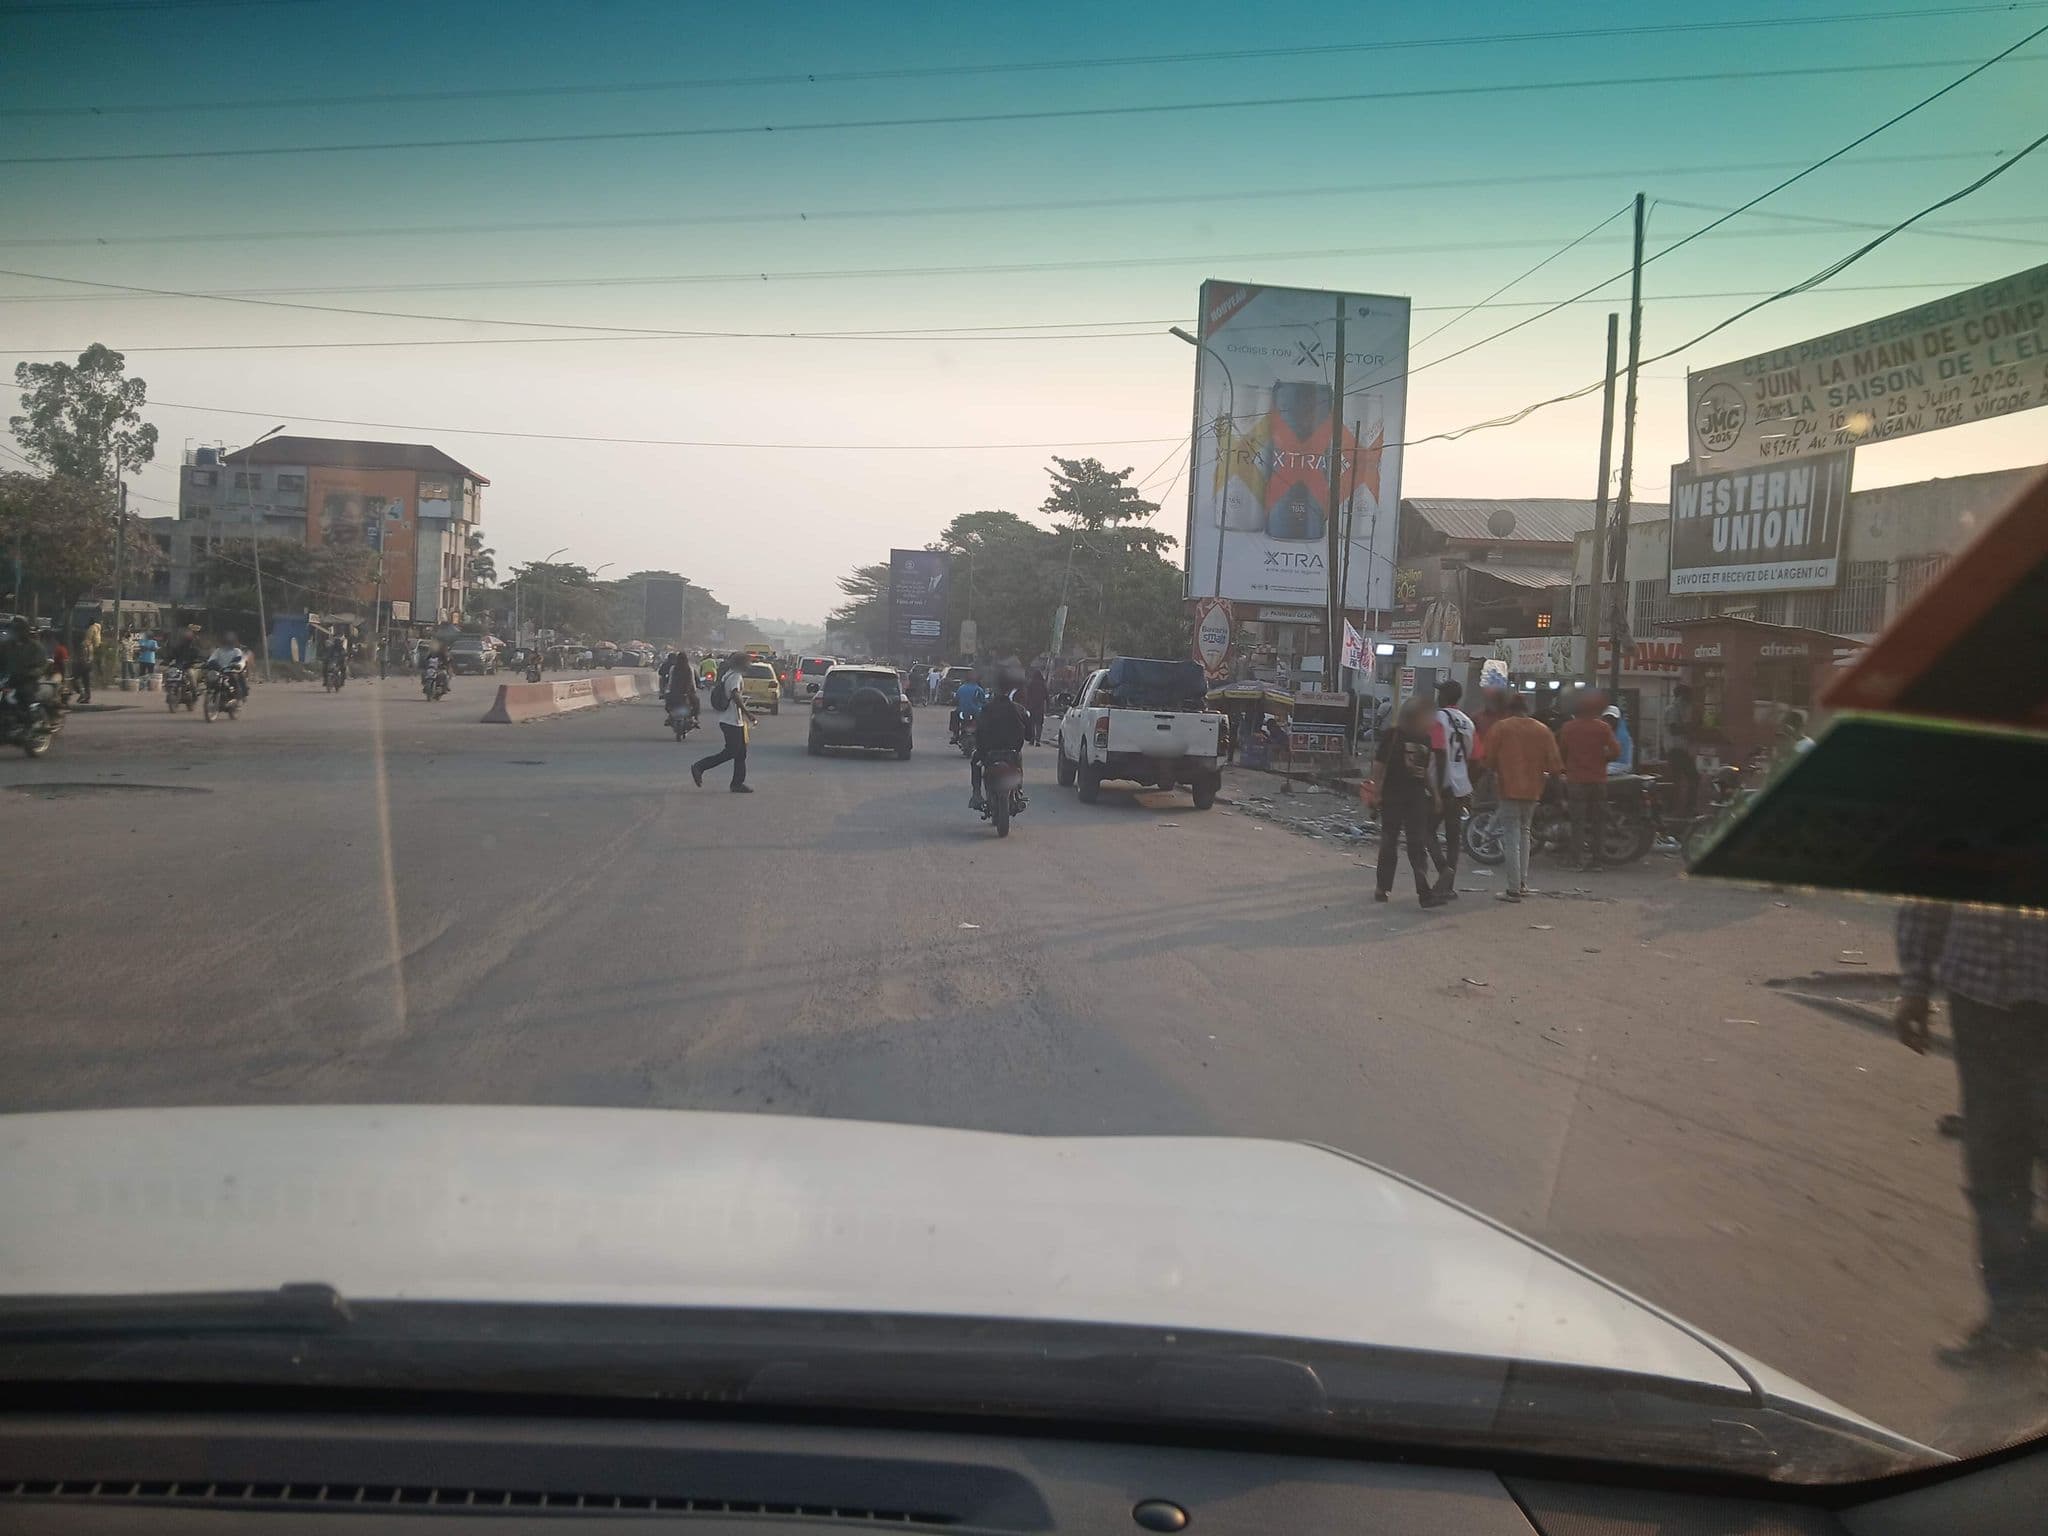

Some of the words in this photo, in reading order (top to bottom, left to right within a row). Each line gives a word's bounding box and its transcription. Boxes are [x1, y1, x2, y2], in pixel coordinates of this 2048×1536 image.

[1272, 349, 1292, 358] TON
[1800, 332, 1865, 362] PAROLE
[1818, 358, 1847, 387] LA
[1853, 338, 1915, 377] MAIN
[1922, 327, 1955, 358] DE
[1787, 394, 1816, 417] LA
[1828, 365, 1925, 408] SAISON
[1938, 351, 1973, 379] DE
[1701, 408, 1740, 434] JMC
[1793, 419, 1818, 437] Du
[1918, 383, 1960, 410] Juin
[1272, 451, 1328, 470] XTRA
[1677, 467, 1810, 519] WESTERN
[1712, 508, 1806, 552] UNION
[1264, 551, 1324, 568] XTRA
[1677, 572, 1710, 585] ENVOYEZ
[1712, 571, 1721, 583] ET
[1722, 570, 1755, 583] RECEVEZ
[1758, 569, 1769, 581] DE
[1770, 567, 1812, 580] L'ARGENT
[1814, 566, 1828, 579] ICI
[1760, 642, 1809, 657] africell
